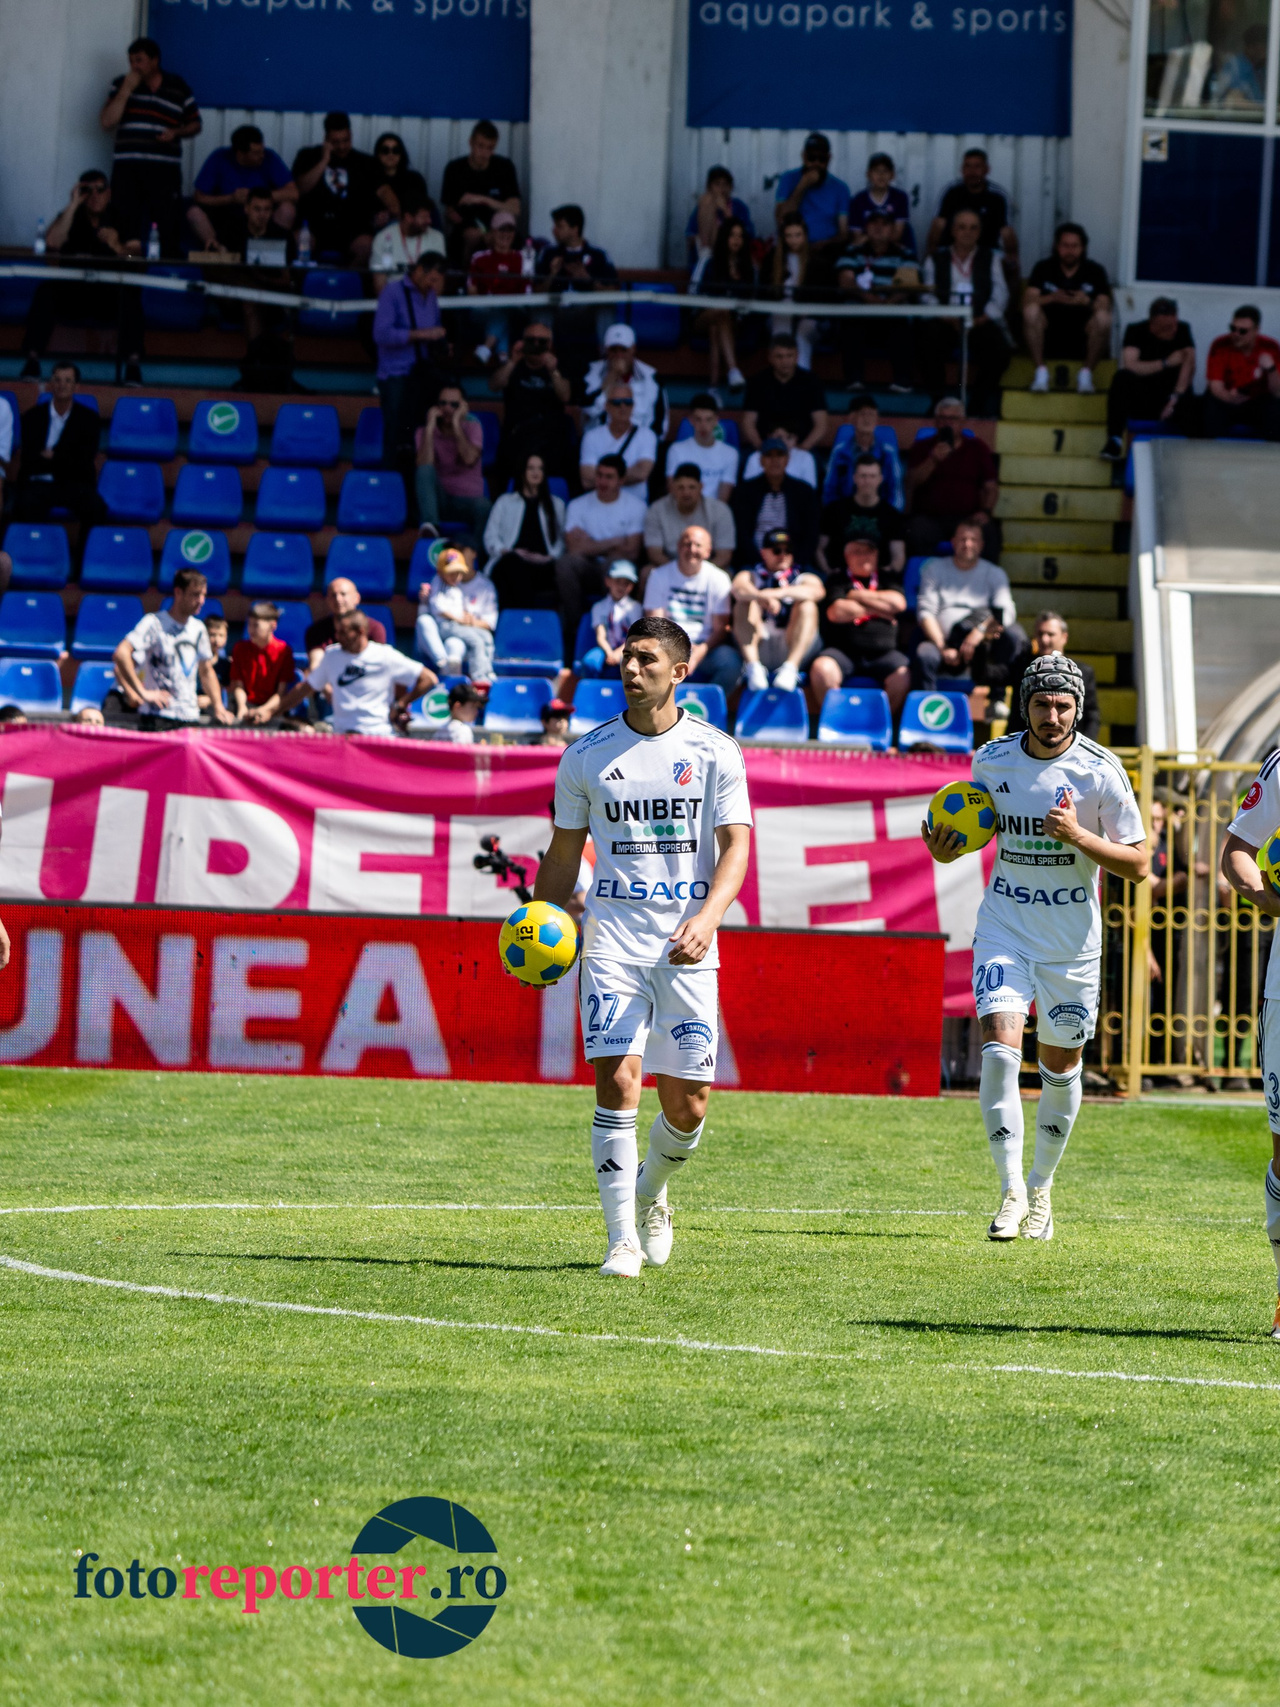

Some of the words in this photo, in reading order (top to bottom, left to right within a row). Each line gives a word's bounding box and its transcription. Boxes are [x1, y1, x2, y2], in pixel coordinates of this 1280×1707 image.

[699, 0, 892, 32] aquapark
[910, 1, 934, 30] &
[952, 4, 1067, 36] sports
[1053, 429, 1065, 452] 7
[1043, 557, 1058, 581] 5
[604, 798, 702, 822] UNIBET
[967, 792, 981, 805] 12
[997, 814, 1044, 837] UNIB
[659, 841, 680, 853] SPRE
[1037, 854, 1057, 865] SPRE
[1058, 855, 1071, 865] 0%
[596, 879, 710, 900] ELSACO
[993, 876, 1088, 906] ELSACO
[520, 926, 534, 941] 12
[975, 962, 1004, 997] 20
[587, 993, 619, 1032] 27
[1050, 1008, 1061, 1018] FIVE
[603, 1037, 633, 1045] Vestra
